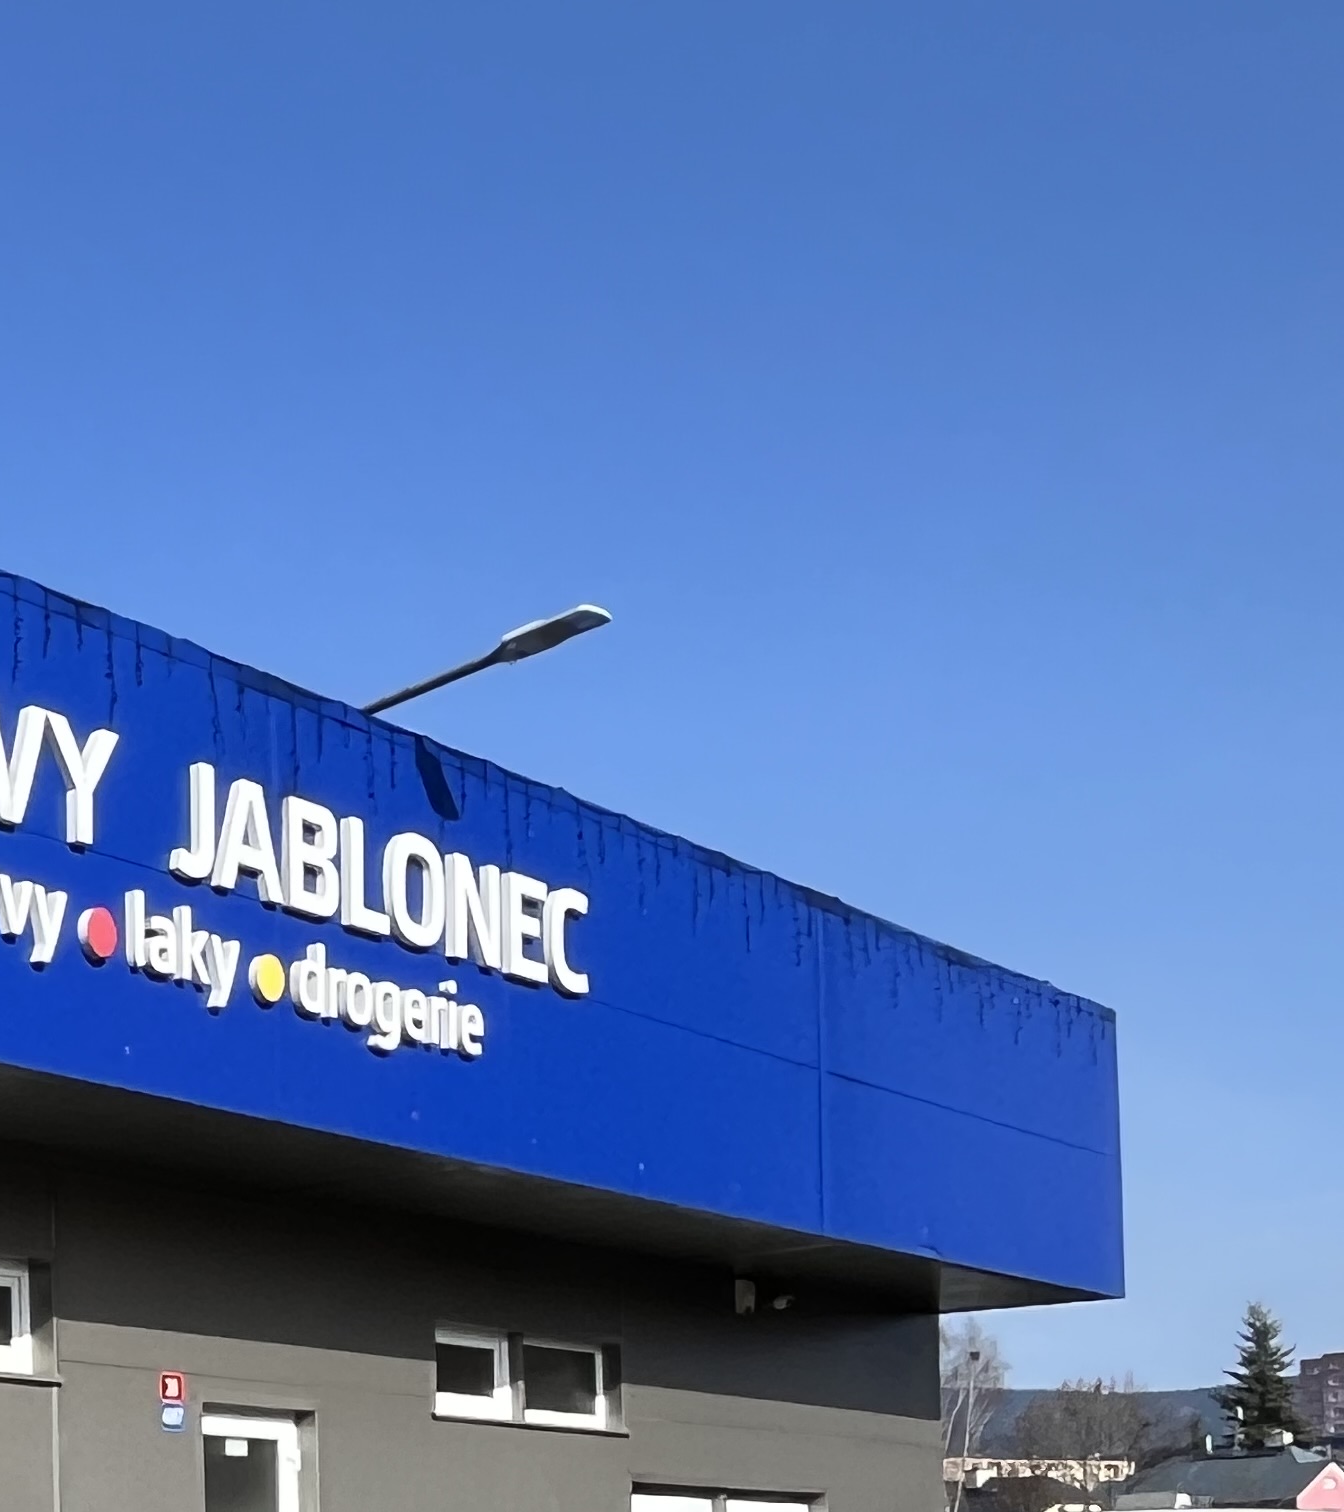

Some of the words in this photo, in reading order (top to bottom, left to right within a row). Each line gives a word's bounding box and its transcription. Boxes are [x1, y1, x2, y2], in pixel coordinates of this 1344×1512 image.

[124, 889, 241, 1008] laky
[289, 942, 485, 1056] drogerie
[169, 762, 590, 994] JABLONEC
